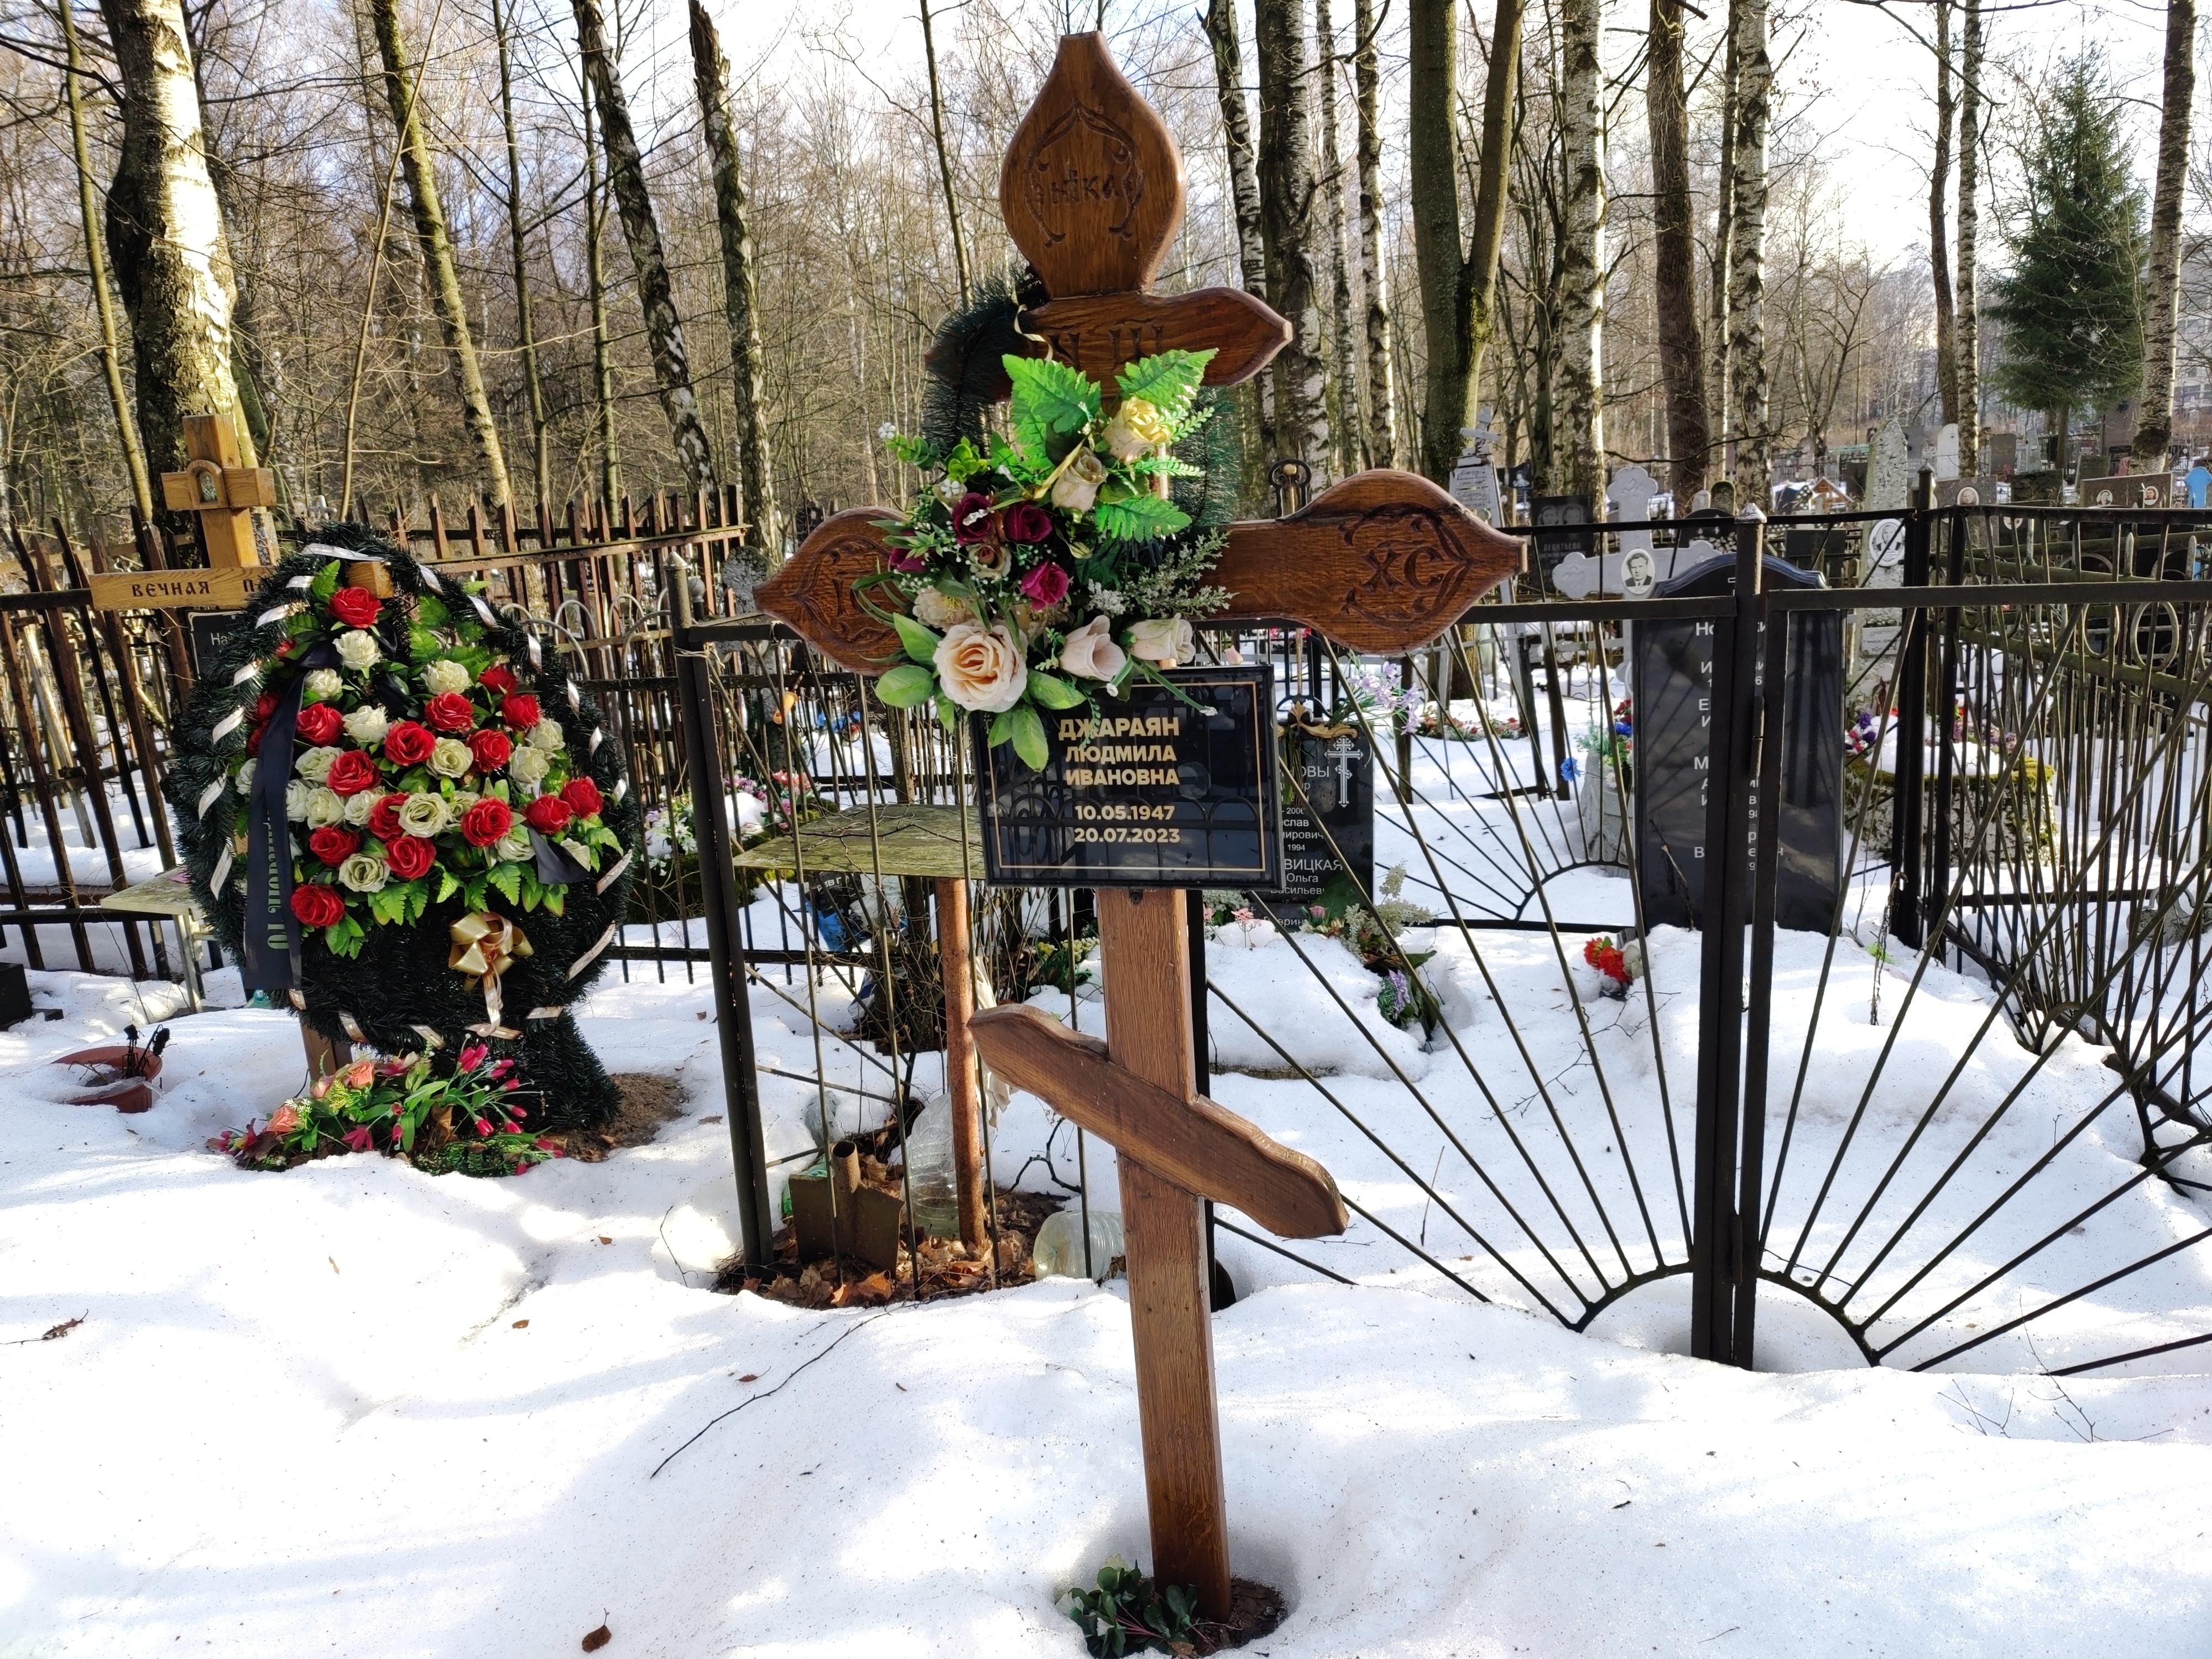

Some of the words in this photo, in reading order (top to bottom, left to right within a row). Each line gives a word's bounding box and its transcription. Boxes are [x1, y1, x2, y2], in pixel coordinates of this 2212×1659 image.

[1058, 717, 1180, 741] ДЖАРАЯН
[1065, 745, 1177, 764] ЛЮДМИЛА
[1066, 769, 1180, 786] ИВАНОВНА
[1074, 805, 1176, 821] 10.05.1947
[1074, 828, 1181, 843] 20.07.2023
[1284, 859, 1343, 873] ВИЦКАЯ
[1286, 873, 1319, 883] Ольга
